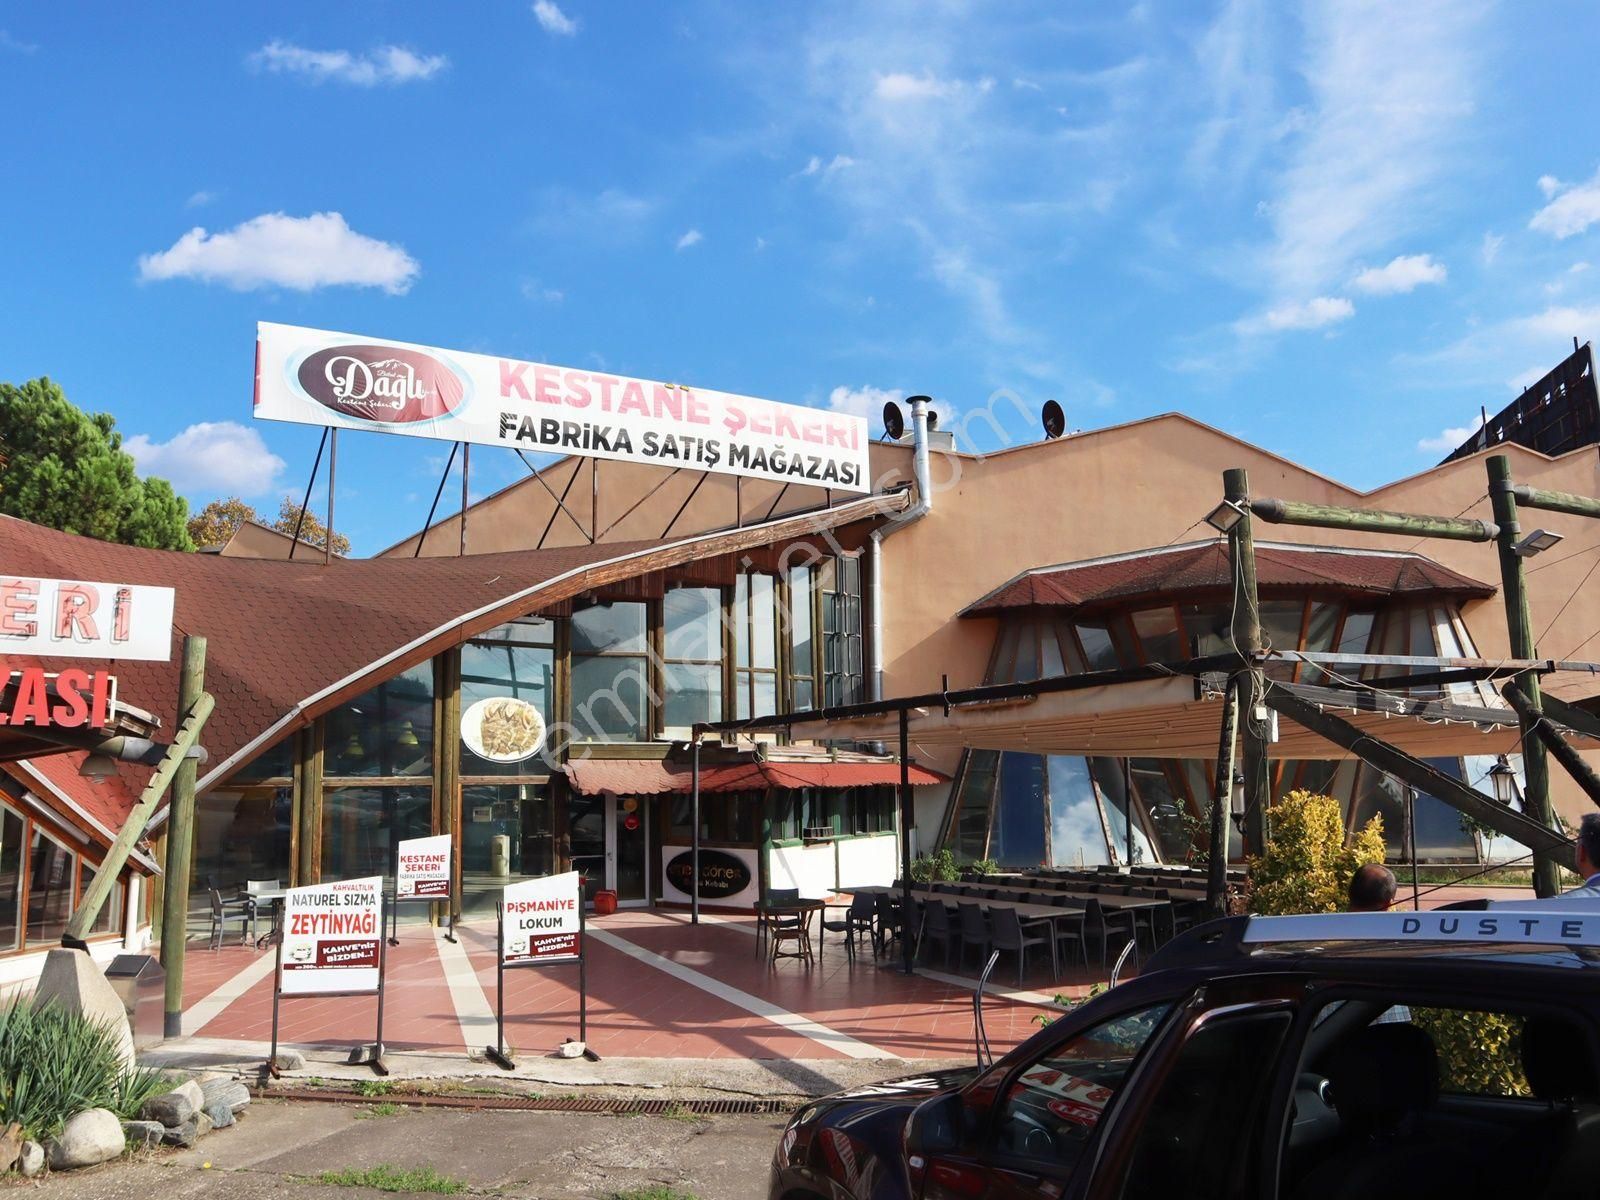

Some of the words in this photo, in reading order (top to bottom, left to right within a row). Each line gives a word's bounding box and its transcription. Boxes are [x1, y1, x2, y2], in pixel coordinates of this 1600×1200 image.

[499, 359, 711, 425] KESTANE
[642, 431, 721, 468] SATIŞ
[728, 443, 861, 486] MAĞAZASI
[400, 855, 446, 863] KESTANE
[292, 894, 341, 906] NATUREL
[344, 893, 376, 906] SIZMA
[291, 908, 376, 935] ZEYTİNYAĞI
[519, 917, 563, 930] LOKUM
[1402, 918, 1584, 938] DUSTE
